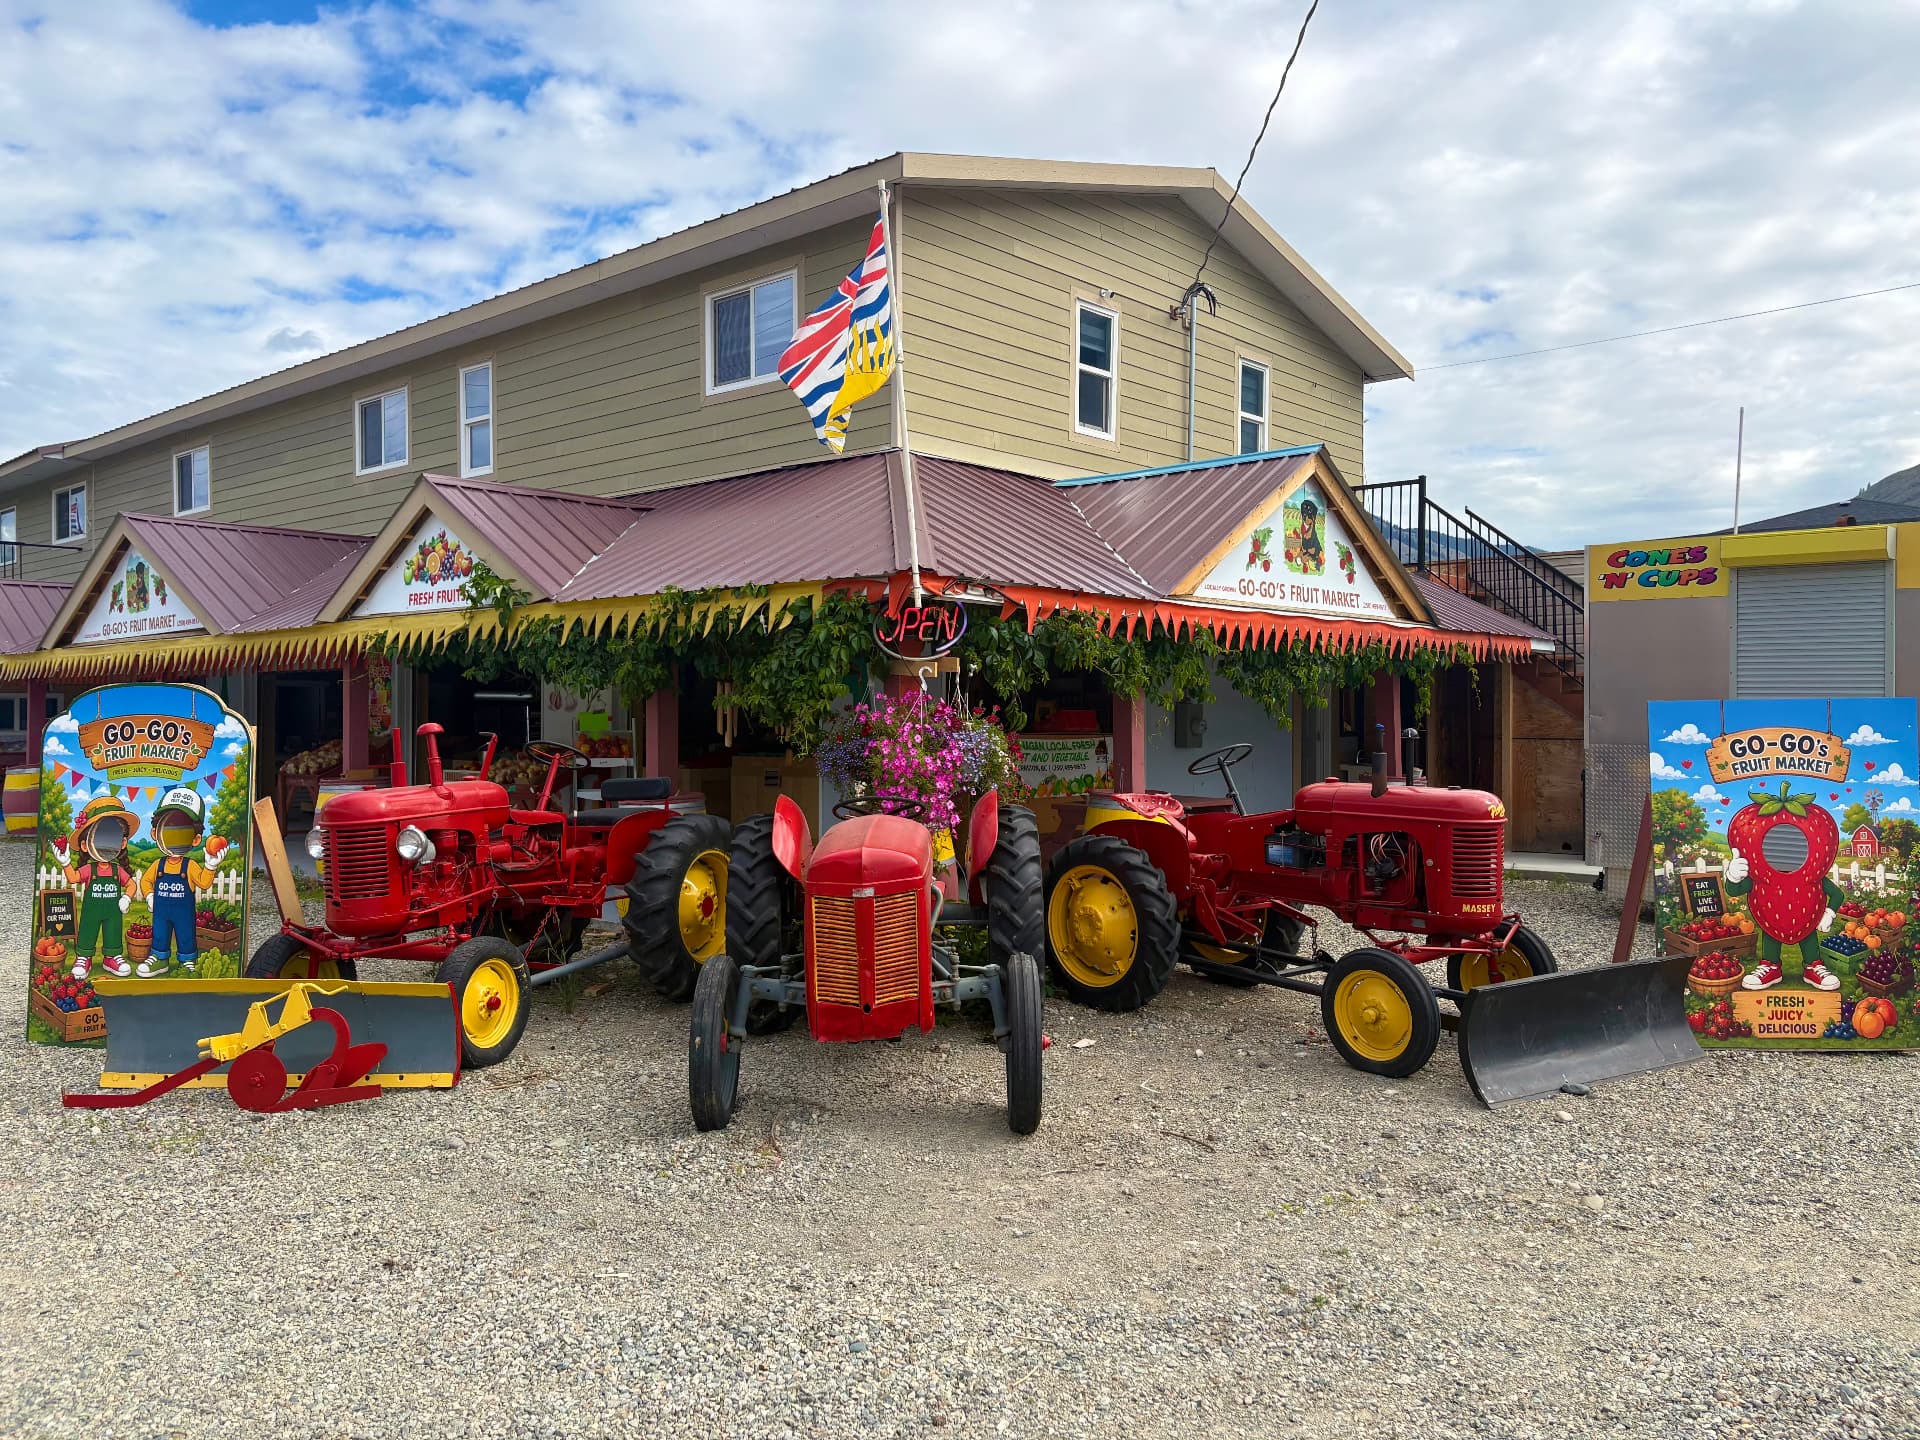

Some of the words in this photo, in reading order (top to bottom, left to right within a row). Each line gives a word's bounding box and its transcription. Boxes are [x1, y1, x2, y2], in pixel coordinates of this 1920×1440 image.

[1606, 545, 1708, 568] CONES
[1598, 572, 1634, 589] 'N'
[1637, 567, 1718, 587] CUPS
[408, 591, 434, 606] FRESH
[1238, 578, 1286, 600] GO-GO'S
[1290, 584, 1319, 604] FRUIT
[1321, 589, 1360, 609] MARKET
[103, 621, 127, 636] GO-GO'S
[129, 618, 147, 633] FRUIT
[149, 614, 176, 629] MARKET
[879, 606, 959, 642] OPEN
[104, 744, 137, 762] FRUIT
[140, 744, 189, 762] MARKET
[1031, 752, 1049, 763] AND
[1051, 751, 1090, 763] VEGETABLE
[112, 767, 127, 775] FRESH
[1731, 757, 1770, 775] FRUIT
[1776, 757, 1832, 774] MARKET
[1695, 881, 1709, 889] EAT
[1693, 889, 1715, 897] FRESH
[49, 897, 68, 905] FRESH
[1698, 897, 1713, 905] LIVE
[1462, 903, 1496, 913] MASSEY
[1696, 905, 1717, 914] WELL!
[1766, 996, 1805, 1008] FRESH
[1767, 1010, 1804, 1021] JUICY
[83, 1024, 99, 1033] FRUIT
[1758, 1023, 1817, 1034] DELICIOUS
